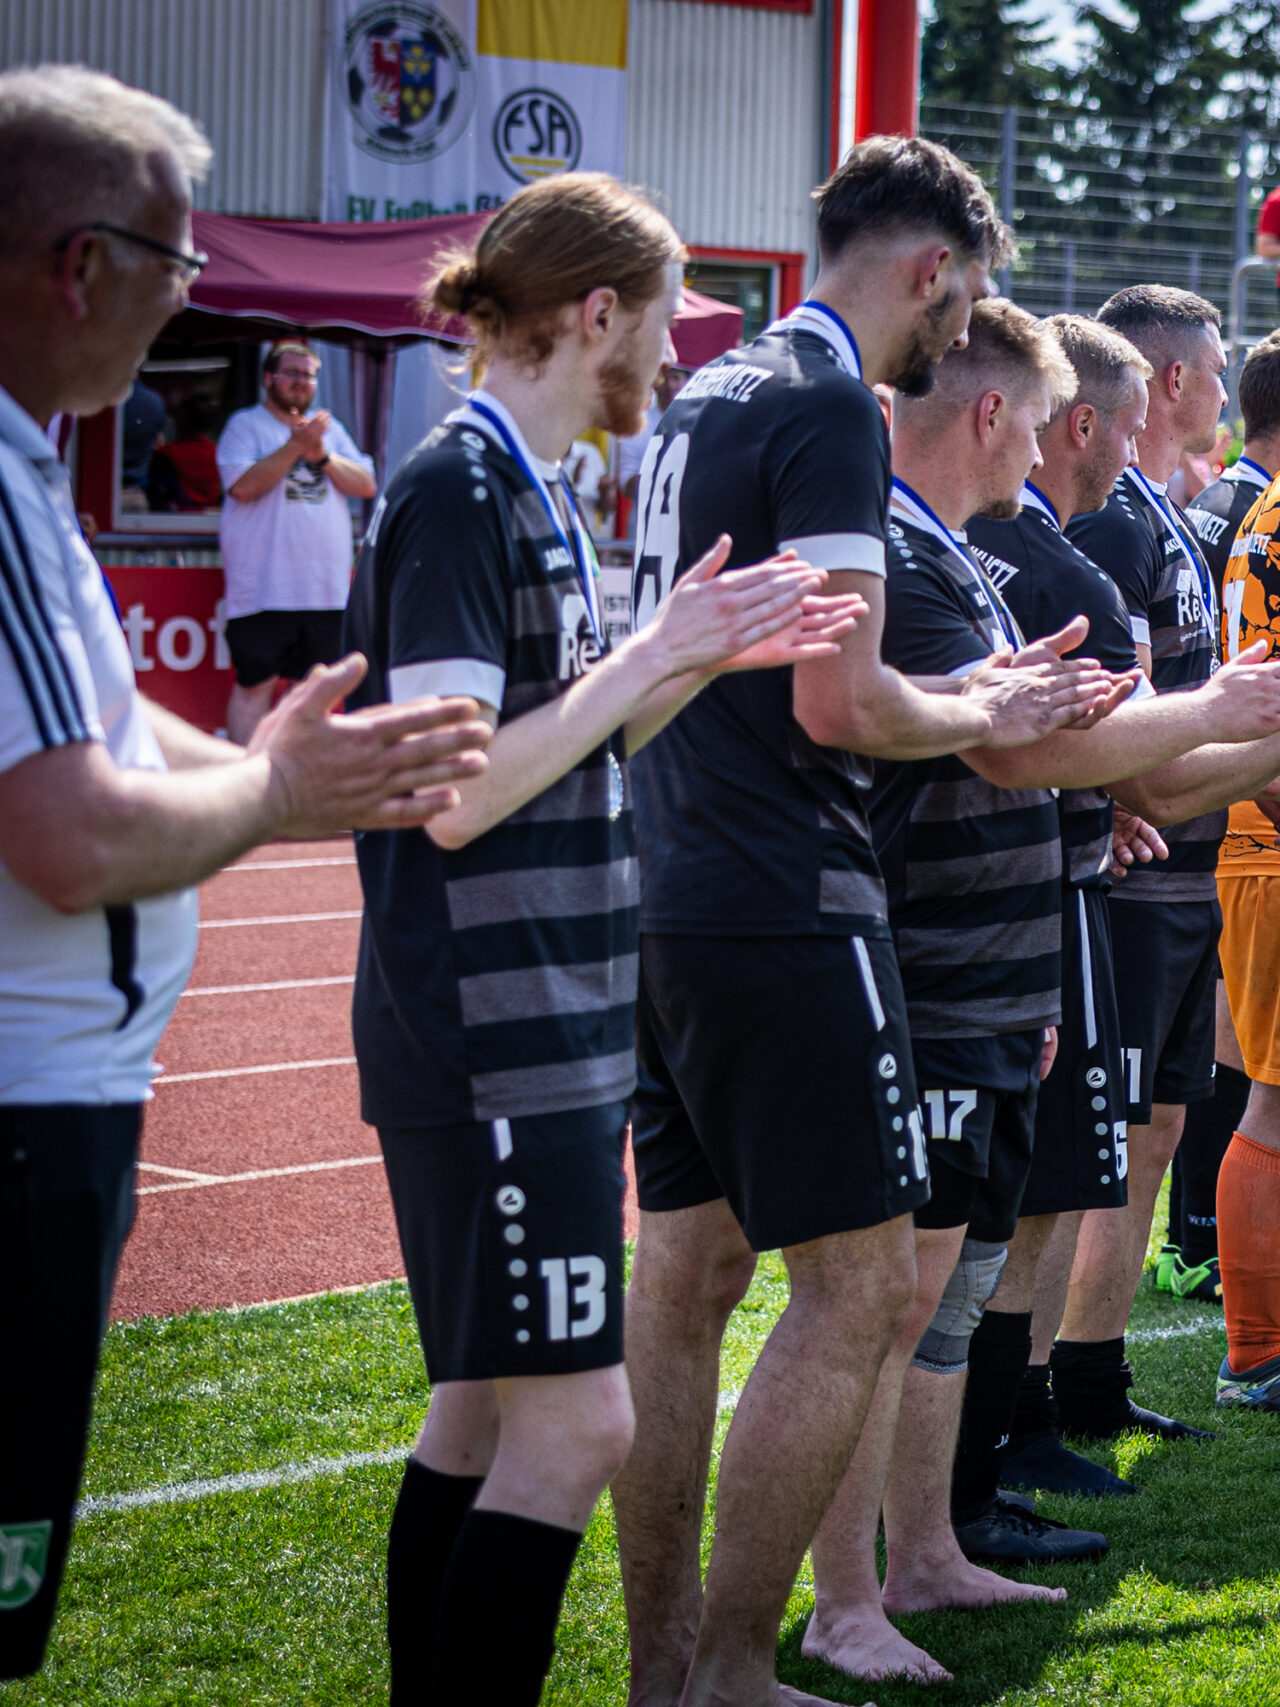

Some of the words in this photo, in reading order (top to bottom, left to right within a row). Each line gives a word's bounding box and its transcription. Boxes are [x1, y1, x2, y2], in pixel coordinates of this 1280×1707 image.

[503, 98, 572, 158] FSA
[925, 1089, 977, 1141] 17
[541, 1254, 606, 1340] 13
